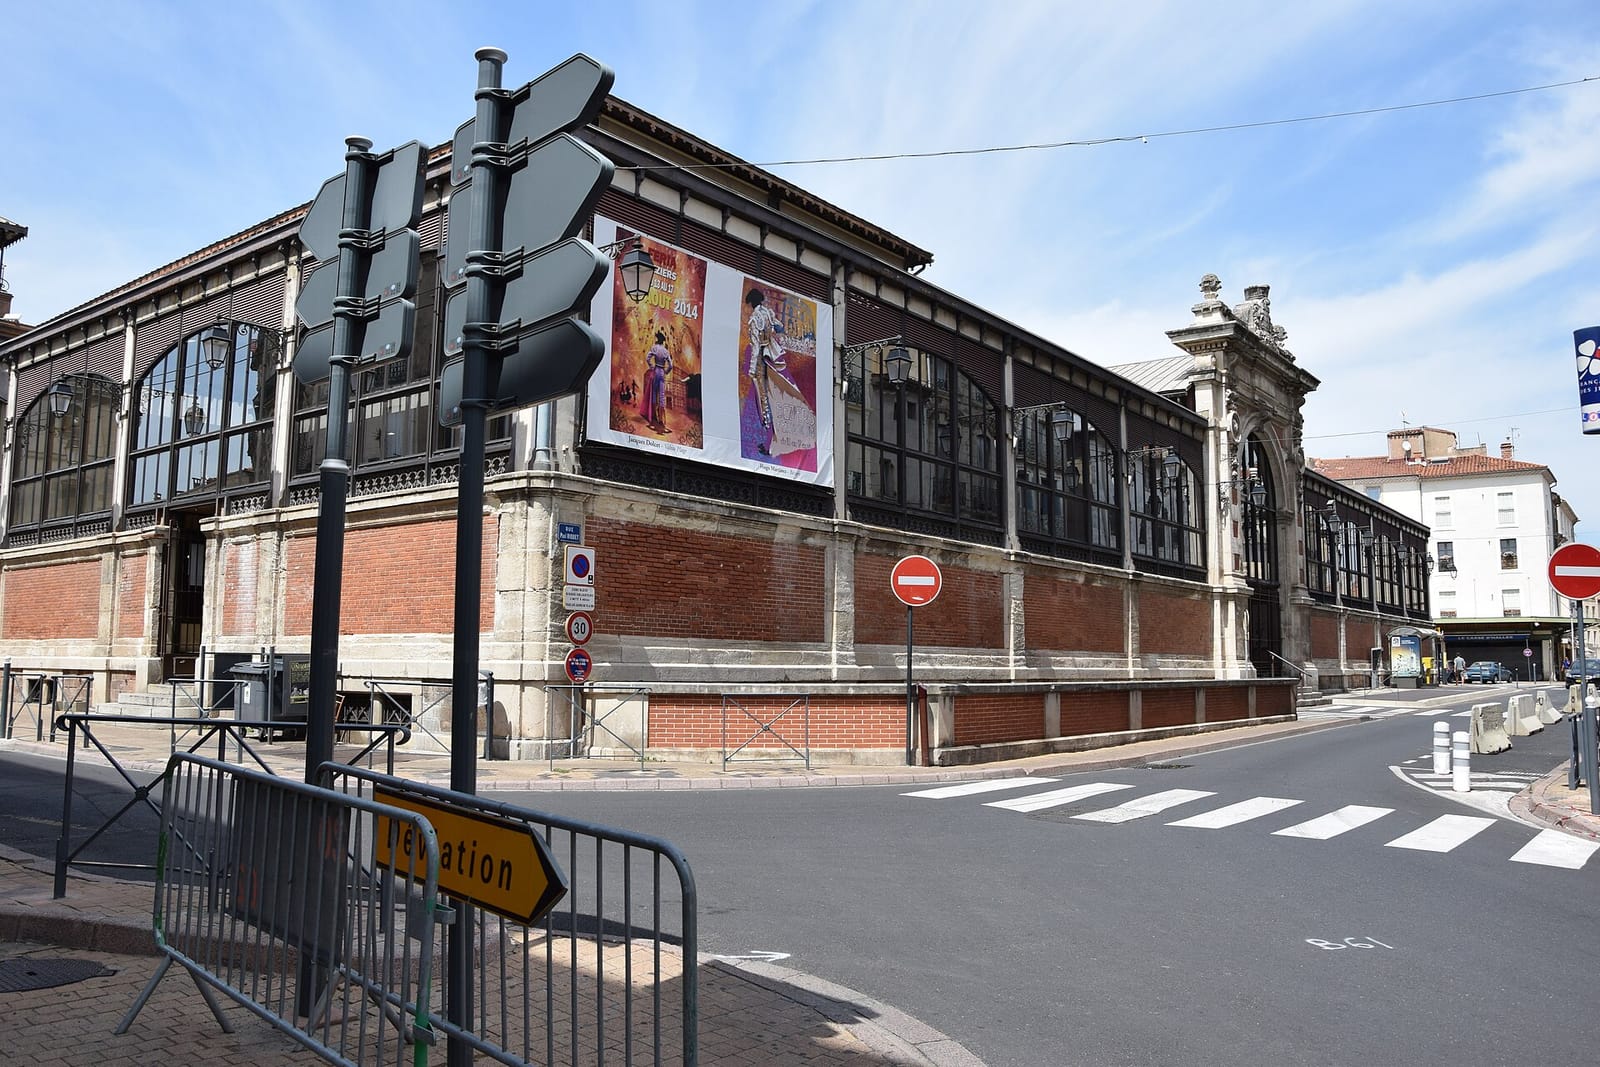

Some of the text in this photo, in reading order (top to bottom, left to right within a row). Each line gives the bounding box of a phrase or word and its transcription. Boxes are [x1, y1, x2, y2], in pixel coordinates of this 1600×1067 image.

[673, 299, 698, 320] 2014
[573, 621, 586, 635] 30
[387, 818, 513, 891] Dévation
